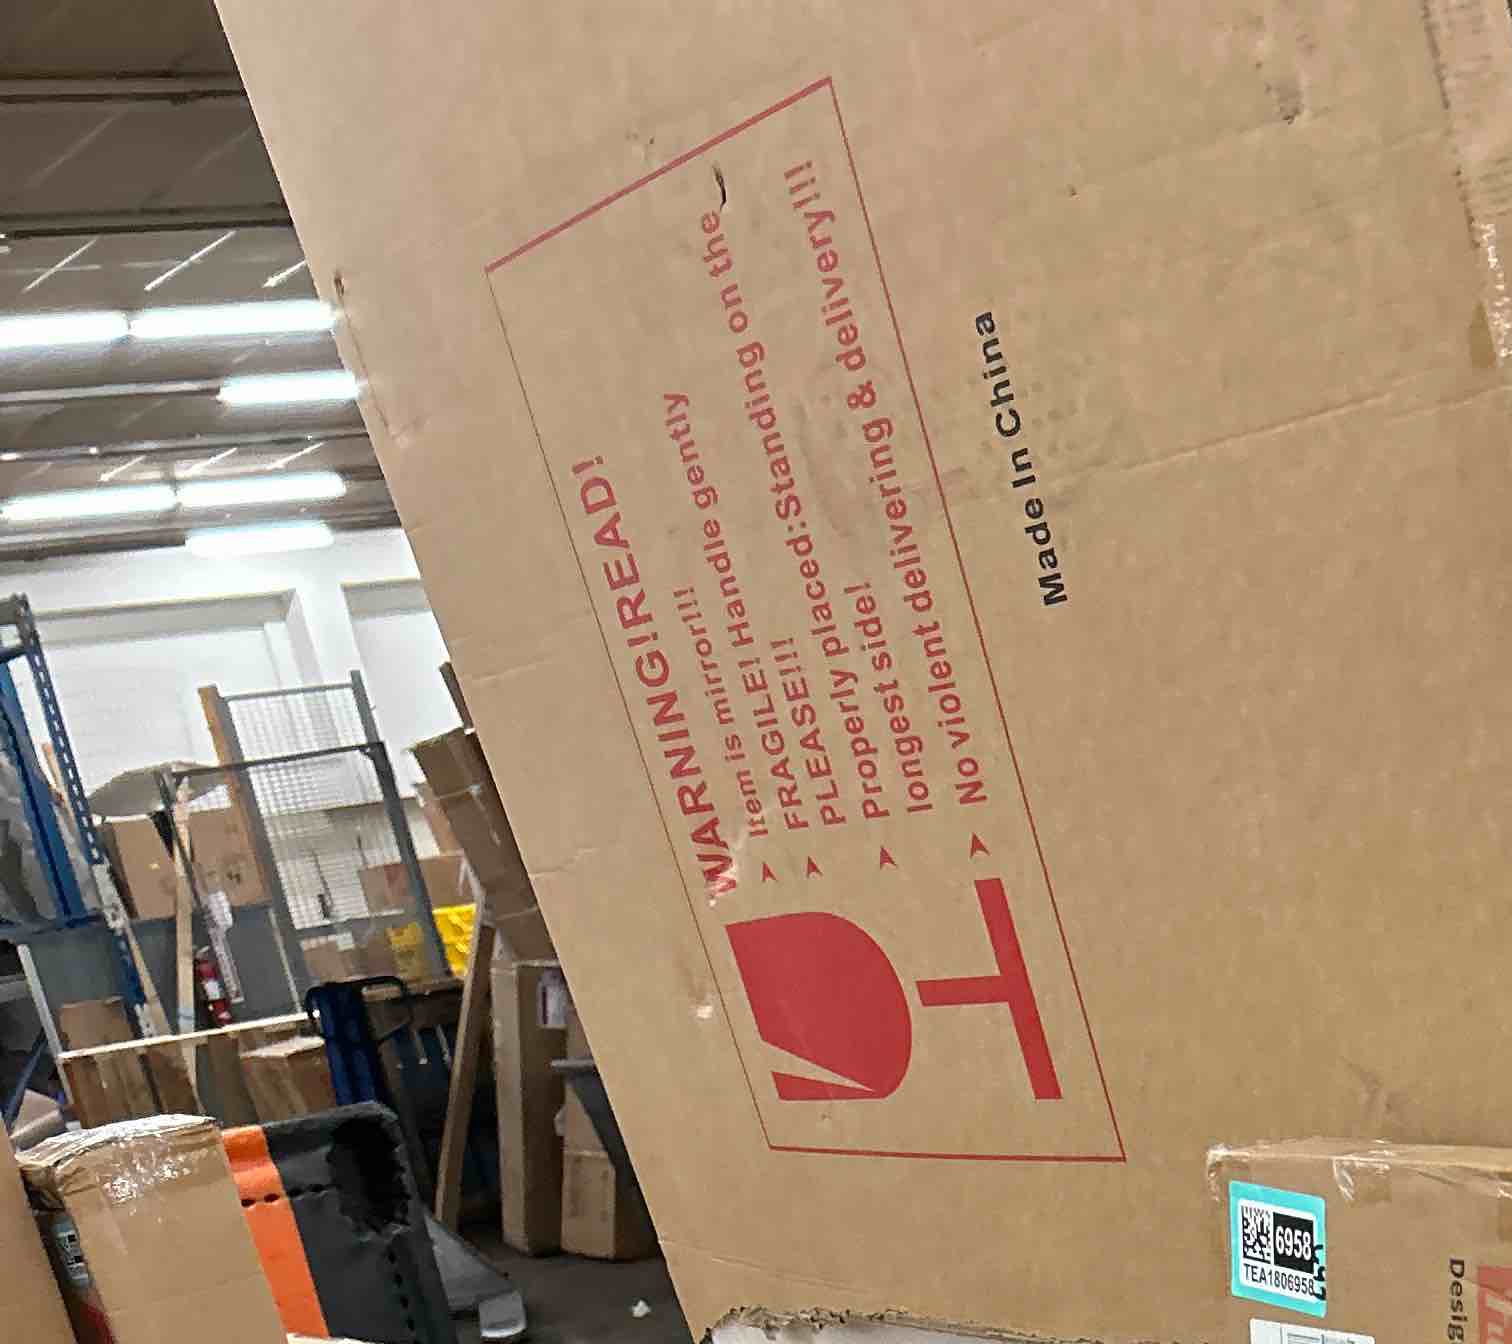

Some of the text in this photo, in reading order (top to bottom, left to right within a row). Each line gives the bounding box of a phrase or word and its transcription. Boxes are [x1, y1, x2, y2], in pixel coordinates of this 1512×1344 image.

[701, 211, 732, 277] the
[720, 283, 749, 333] on
[784, 160, 987, 805] No violent delivering & delivery!!!
[975, 311, 1068, 606] Made In China
[664, 393, 809, 830] FRAGILE! Handle gently
[844, 583, 933, 813] longest side!
[673, 587, 768, 837] Item is mirror!!!
[770, 638, 847, 826] PLEASE!!!
[830, 668, 890, 820] Properly
[1244, 1263, 1314, 1297] TEA1806958
[1275, 1226, 1312, 1260] 6958
